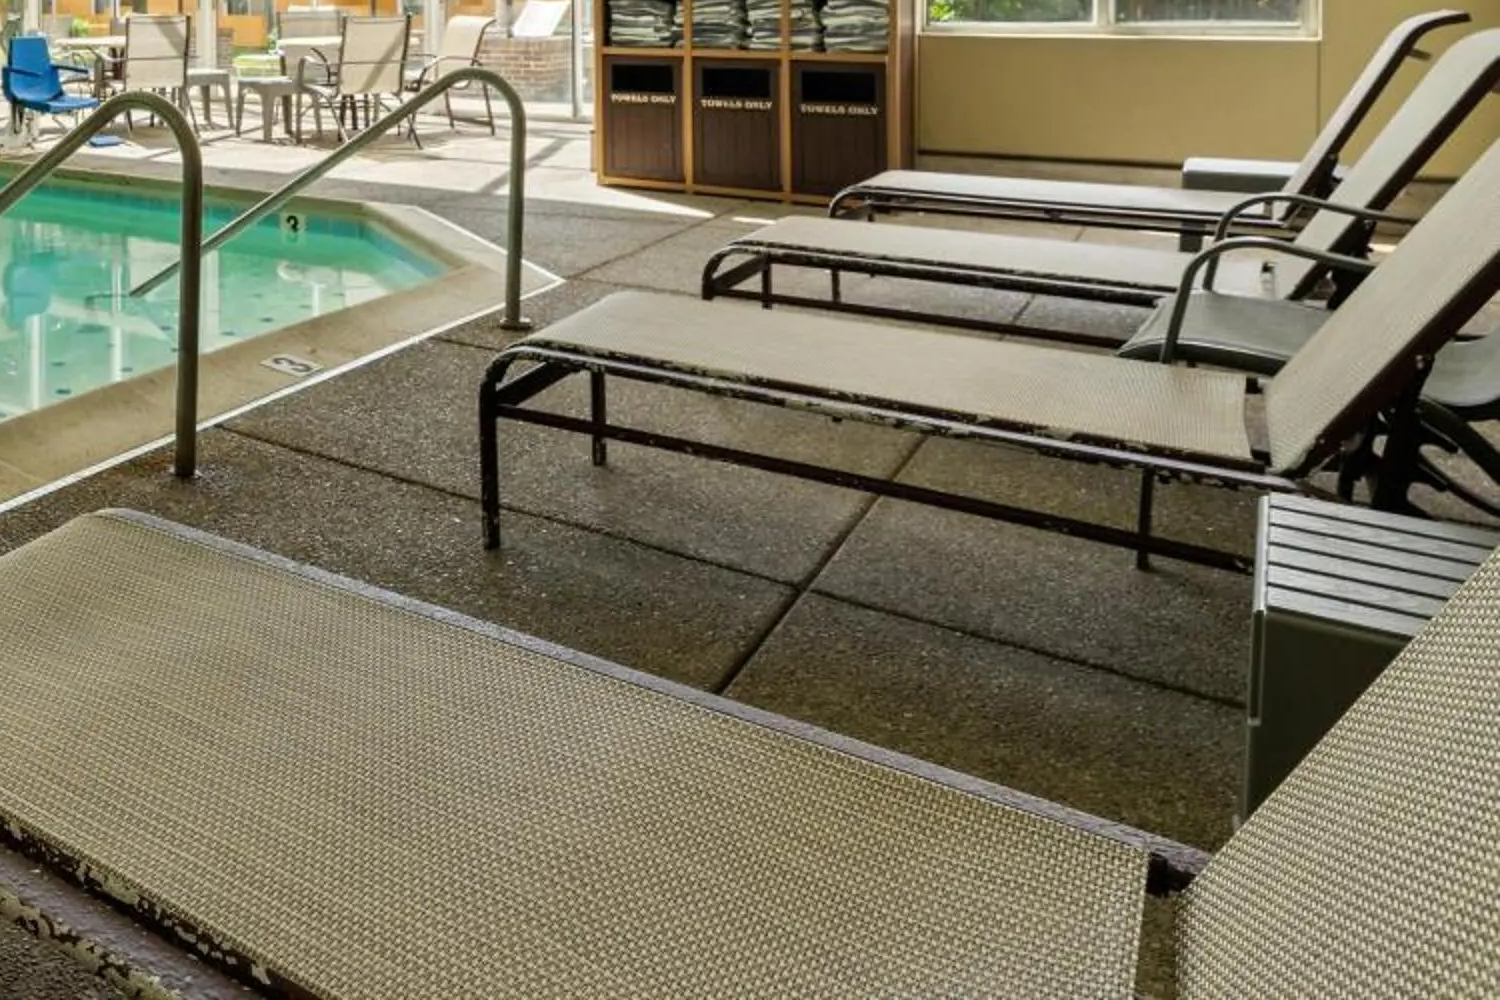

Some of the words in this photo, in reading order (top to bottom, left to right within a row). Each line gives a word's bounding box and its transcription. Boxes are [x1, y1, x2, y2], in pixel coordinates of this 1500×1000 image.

[611, 93, 649, 103] TOWELS
[650, 95, 676, 104] ONLY
[273, 357, 311, 373] 3
